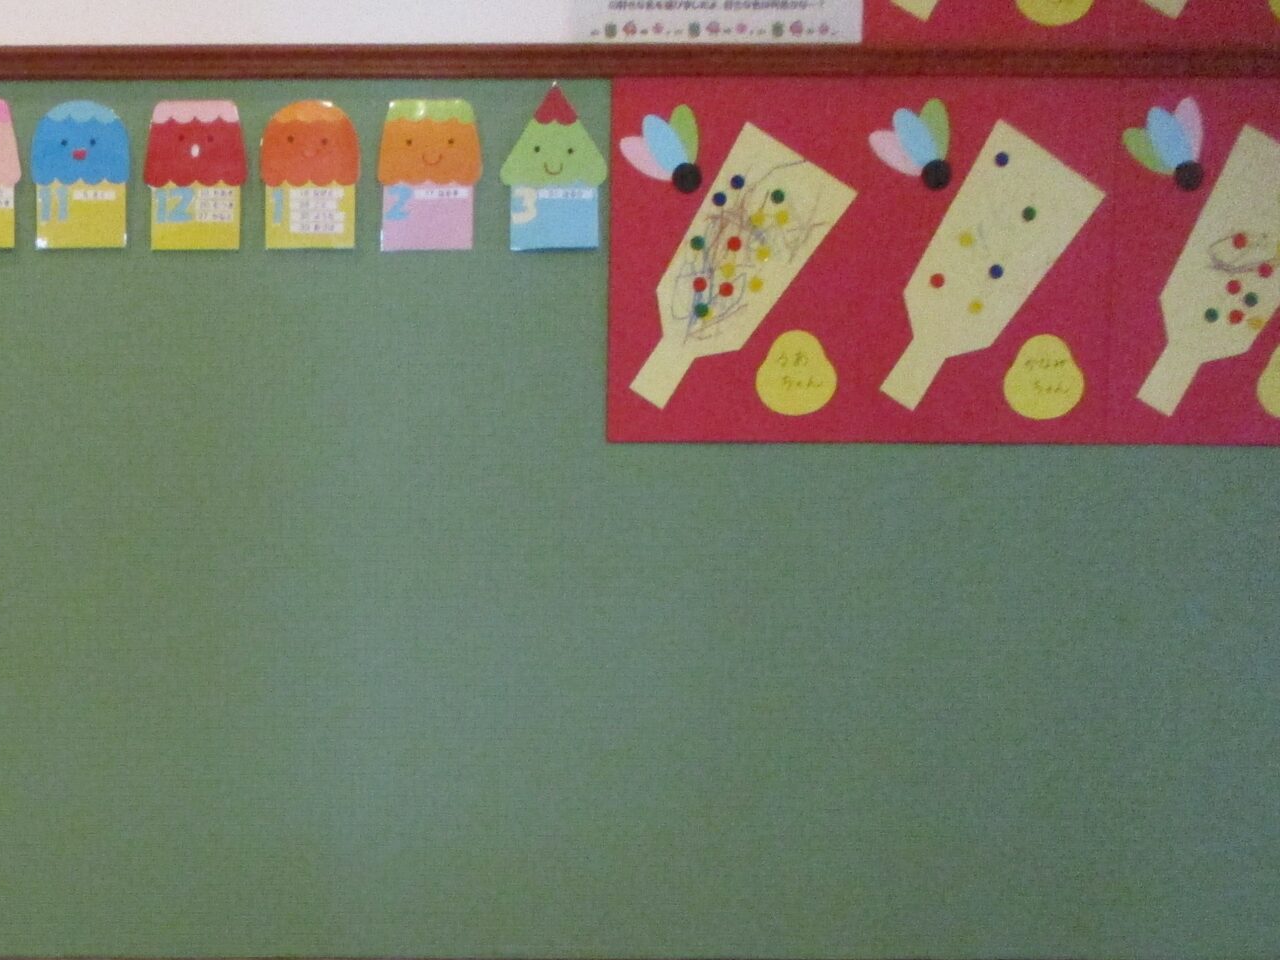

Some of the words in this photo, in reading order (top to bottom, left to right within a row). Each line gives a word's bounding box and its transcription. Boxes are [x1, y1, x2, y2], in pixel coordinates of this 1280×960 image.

[40, 187, 68, 222] 11
[155, 188, 195, 223] 12
[273, 189, 283, 224] 1
[385, 186, 413, 220] 2
[511, 187, 537, 224] 3
